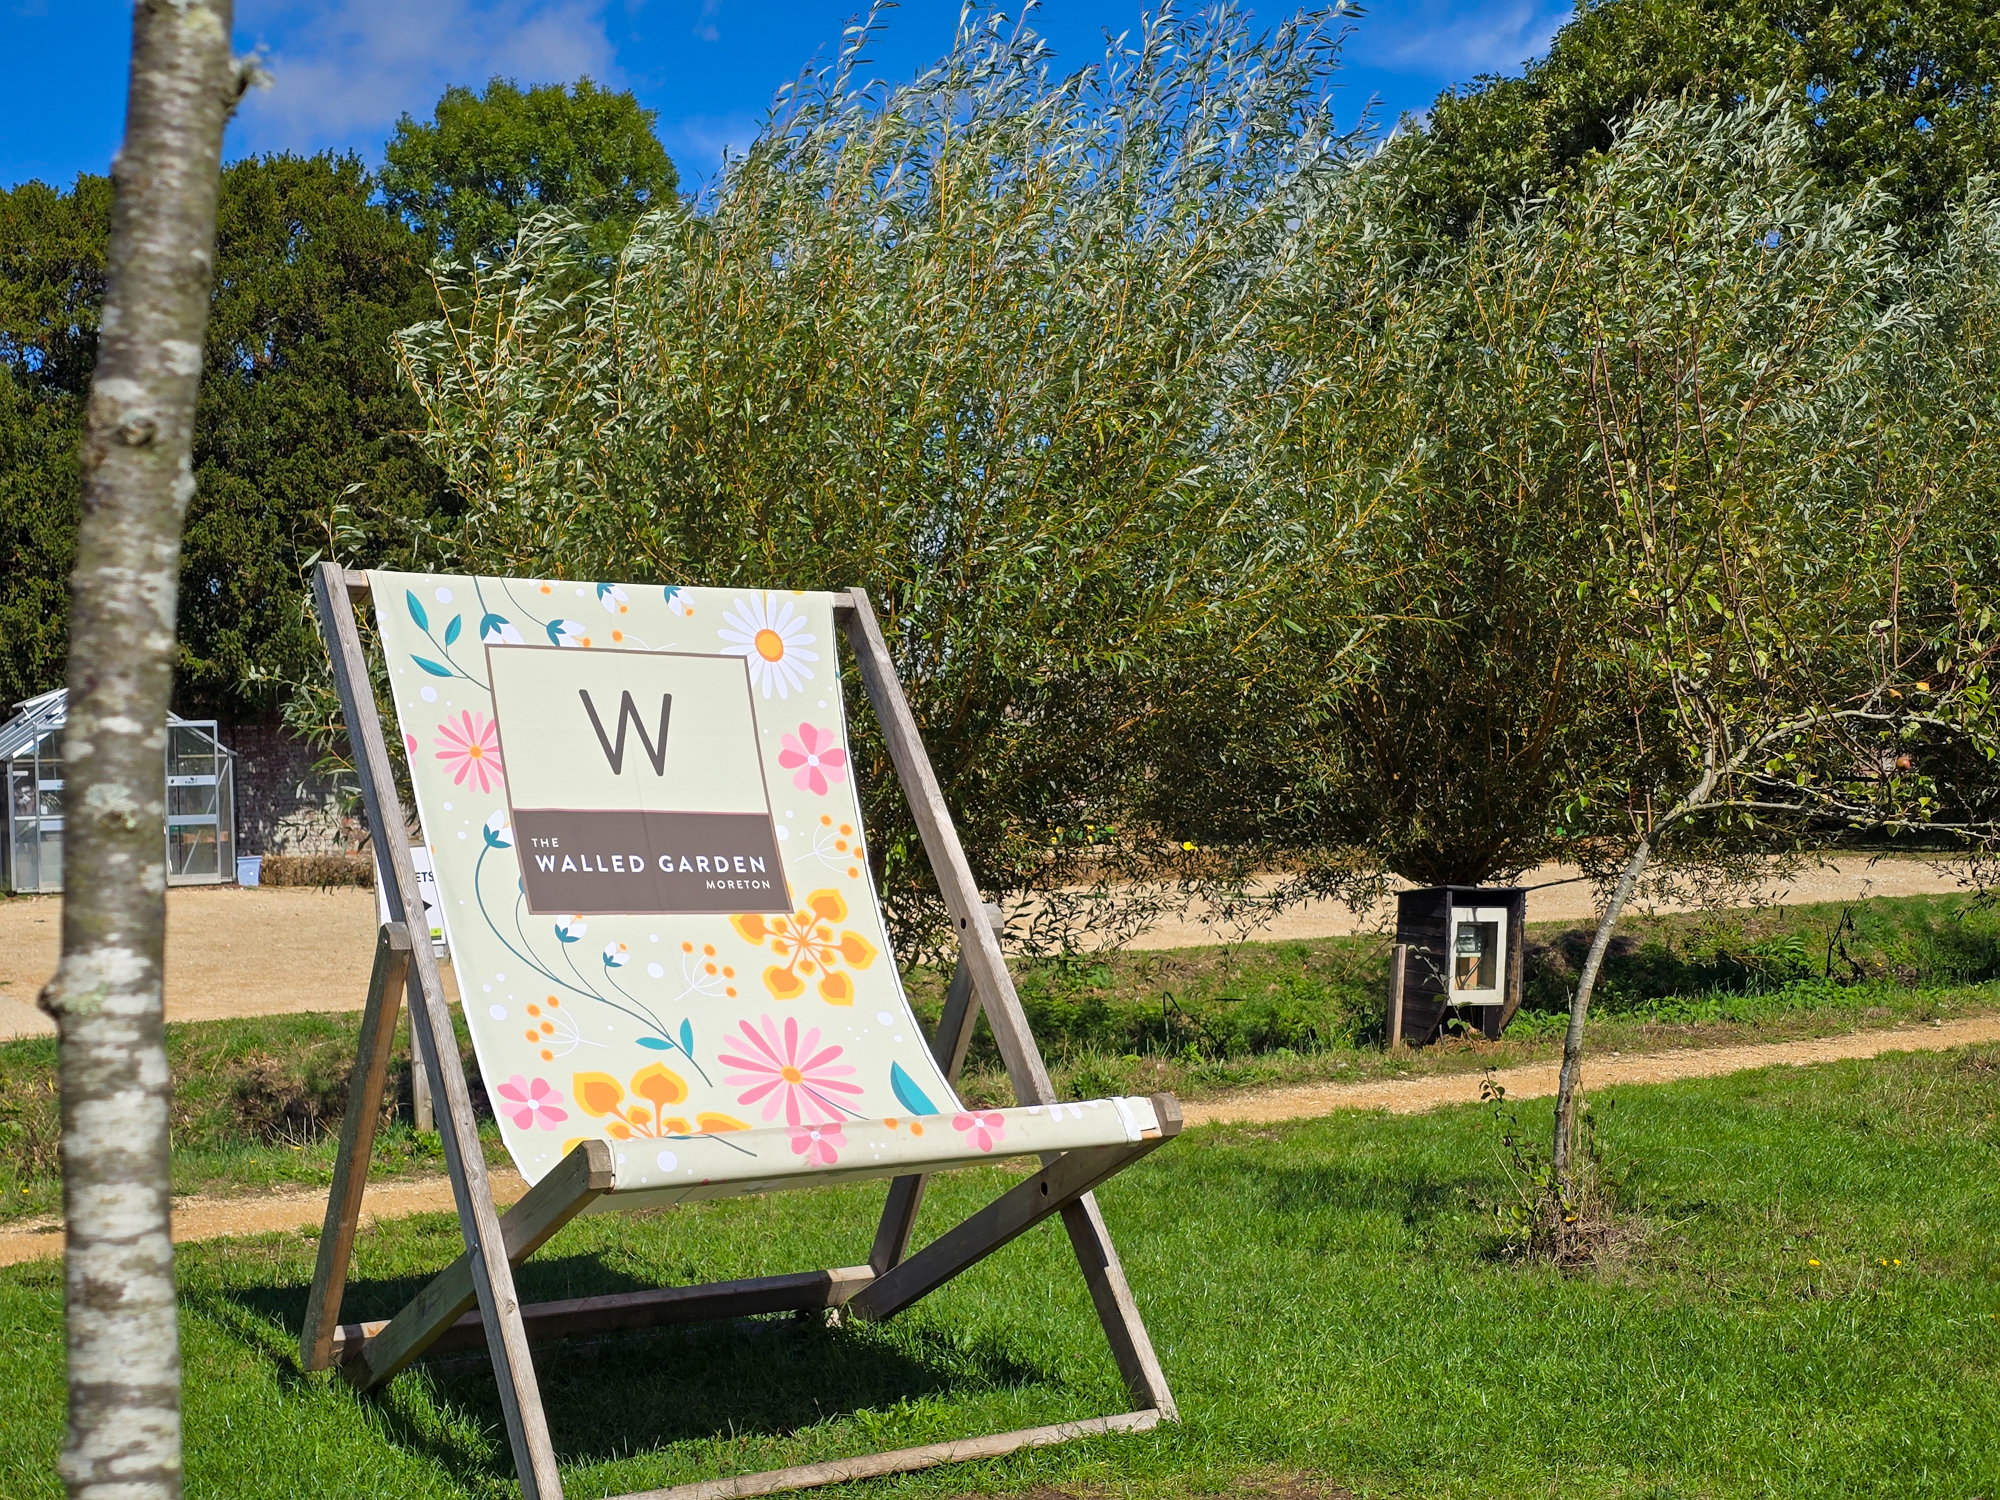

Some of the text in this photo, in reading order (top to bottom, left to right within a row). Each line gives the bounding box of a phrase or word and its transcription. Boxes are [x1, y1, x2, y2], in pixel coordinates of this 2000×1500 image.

[578, 689, 673, 777] W
[530, 837, 559, 848] THE
[534, 854, 766, 874] WALLED GARDEN
[705, 879, 771, 890] MORETON
